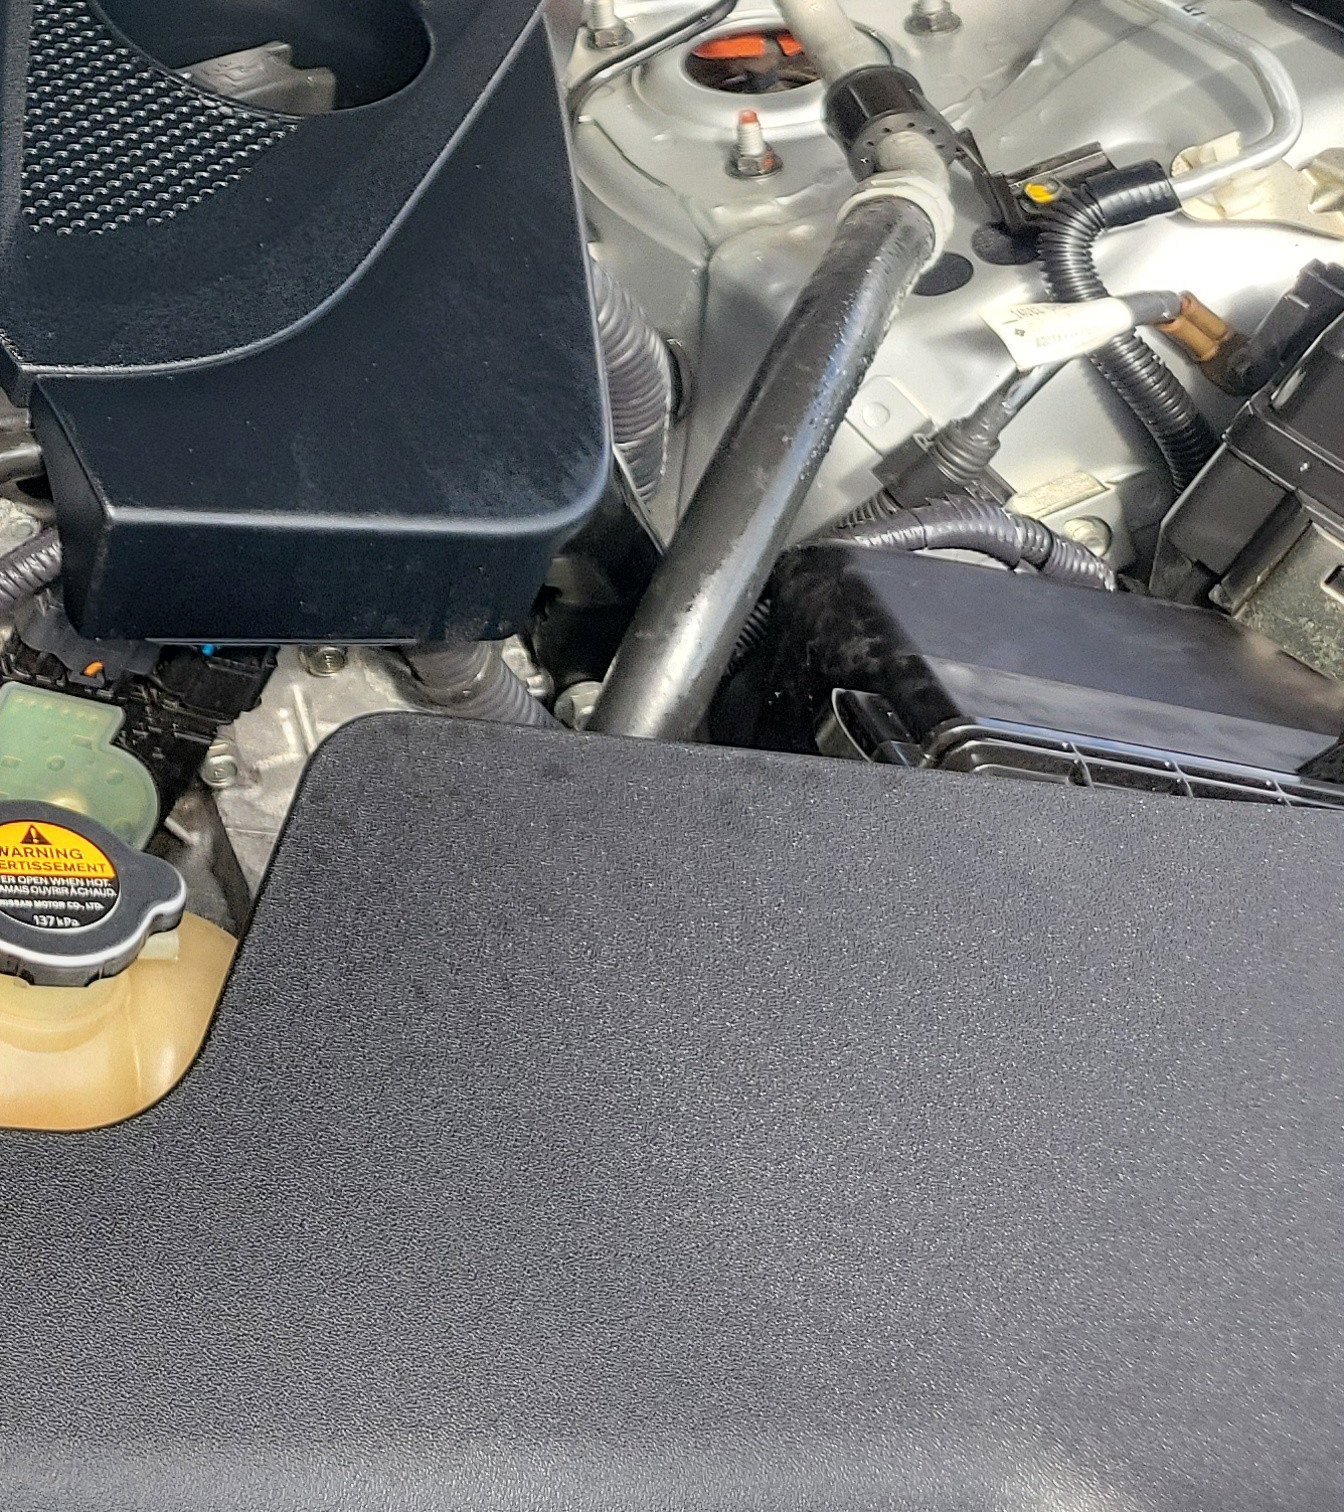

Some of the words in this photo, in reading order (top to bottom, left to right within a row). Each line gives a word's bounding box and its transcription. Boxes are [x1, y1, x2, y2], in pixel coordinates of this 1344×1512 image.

[17, 875, 48, 885] OPEN
[49, 877, 85, 887] WHEN
[86, 878, 112, 887] HOT.
[31, 885, 70, 896] OUVRIR
[77, 887, 117, 898] CHAUD.
[33, 900, 66, 909] MOTOR
[32, 914, 54, 926] 137
[56, 916, 81, 927] kPa
